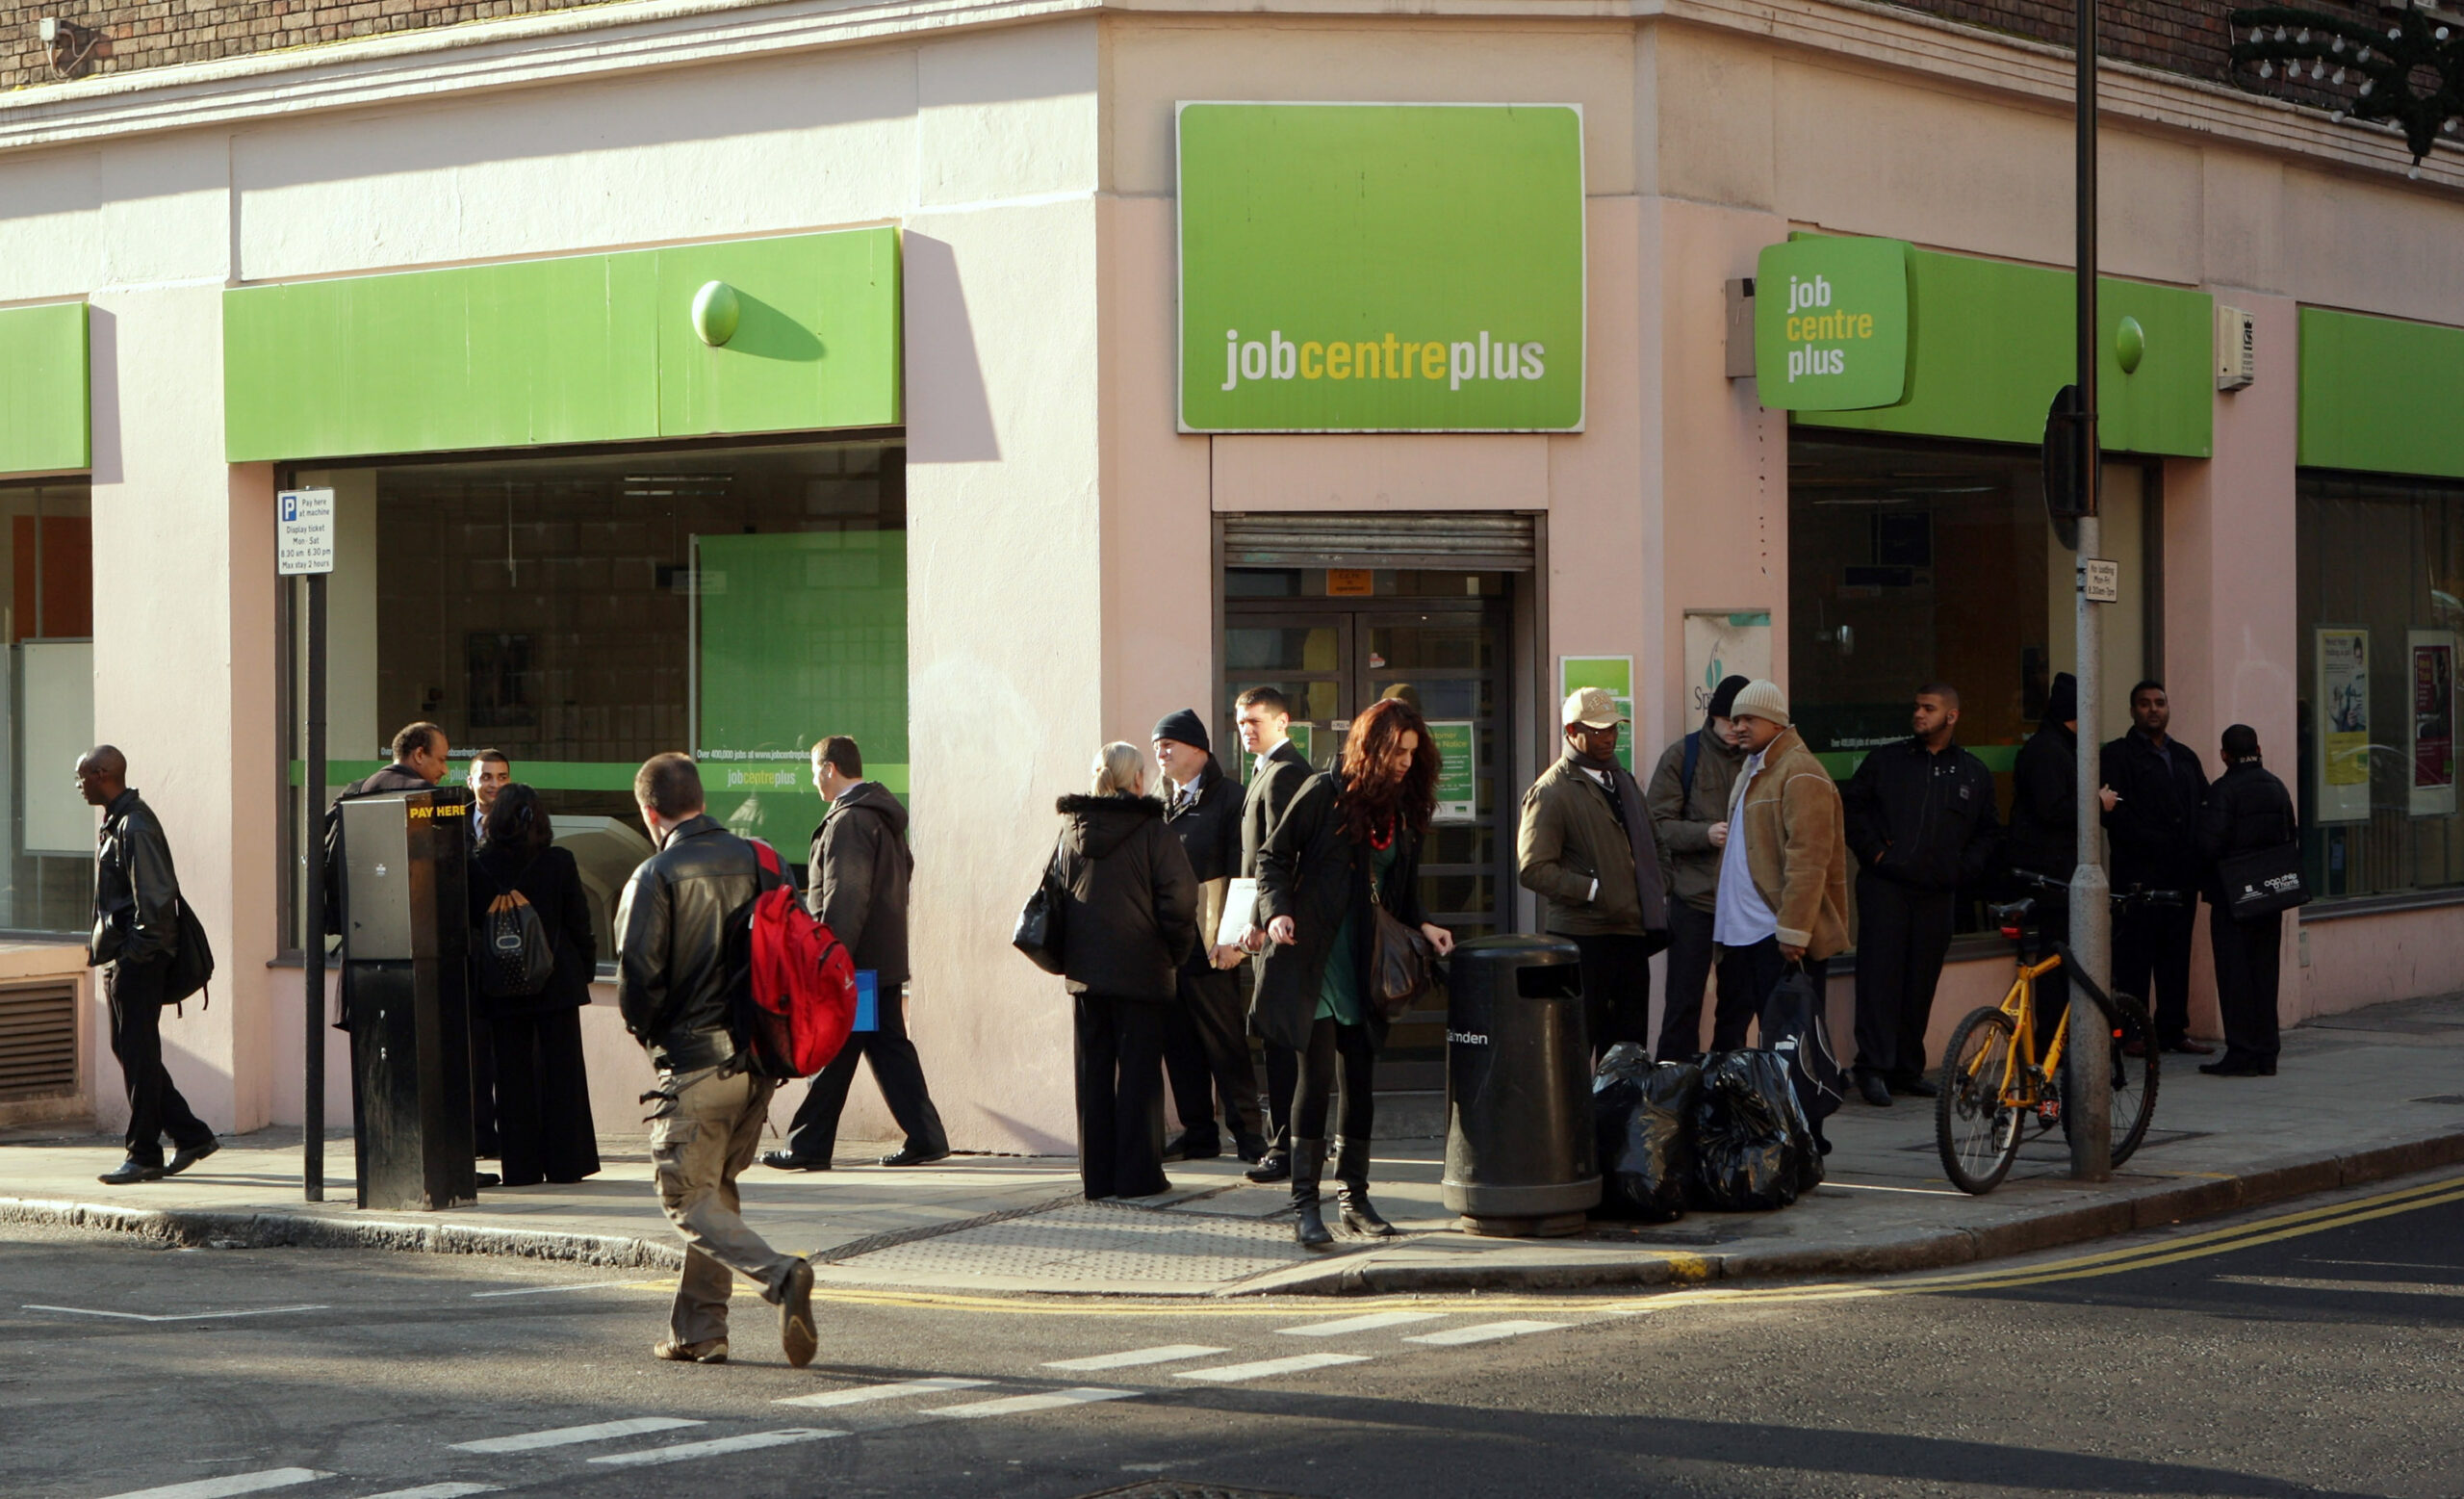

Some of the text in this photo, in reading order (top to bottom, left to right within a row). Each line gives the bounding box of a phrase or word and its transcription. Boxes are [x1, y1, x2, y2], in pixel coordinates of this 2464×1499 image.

[1787, 274, 1831, 314] job
[1786, 309, 1873, 342] centre
[1221, 328, 1545, 391] jobcentreplus
[1788, 343, 1844, 383] plus
[284, 498, 295, 521] P
[301, 499, 313, 507] Pay
[306, 507, 330, 516] machine
[286, 526, 307, 534] Display
[309, 536, 320, 545] Sat
[321, 548, 331, 556] pm
[697, 750, 710, 759] Over
[734, 750, 747, 761] jobs
[748, 750, 755, 759] at
[727, 769, 796, 788] jobcentreplus
[409, 805, 466, 818] PAY HERE
